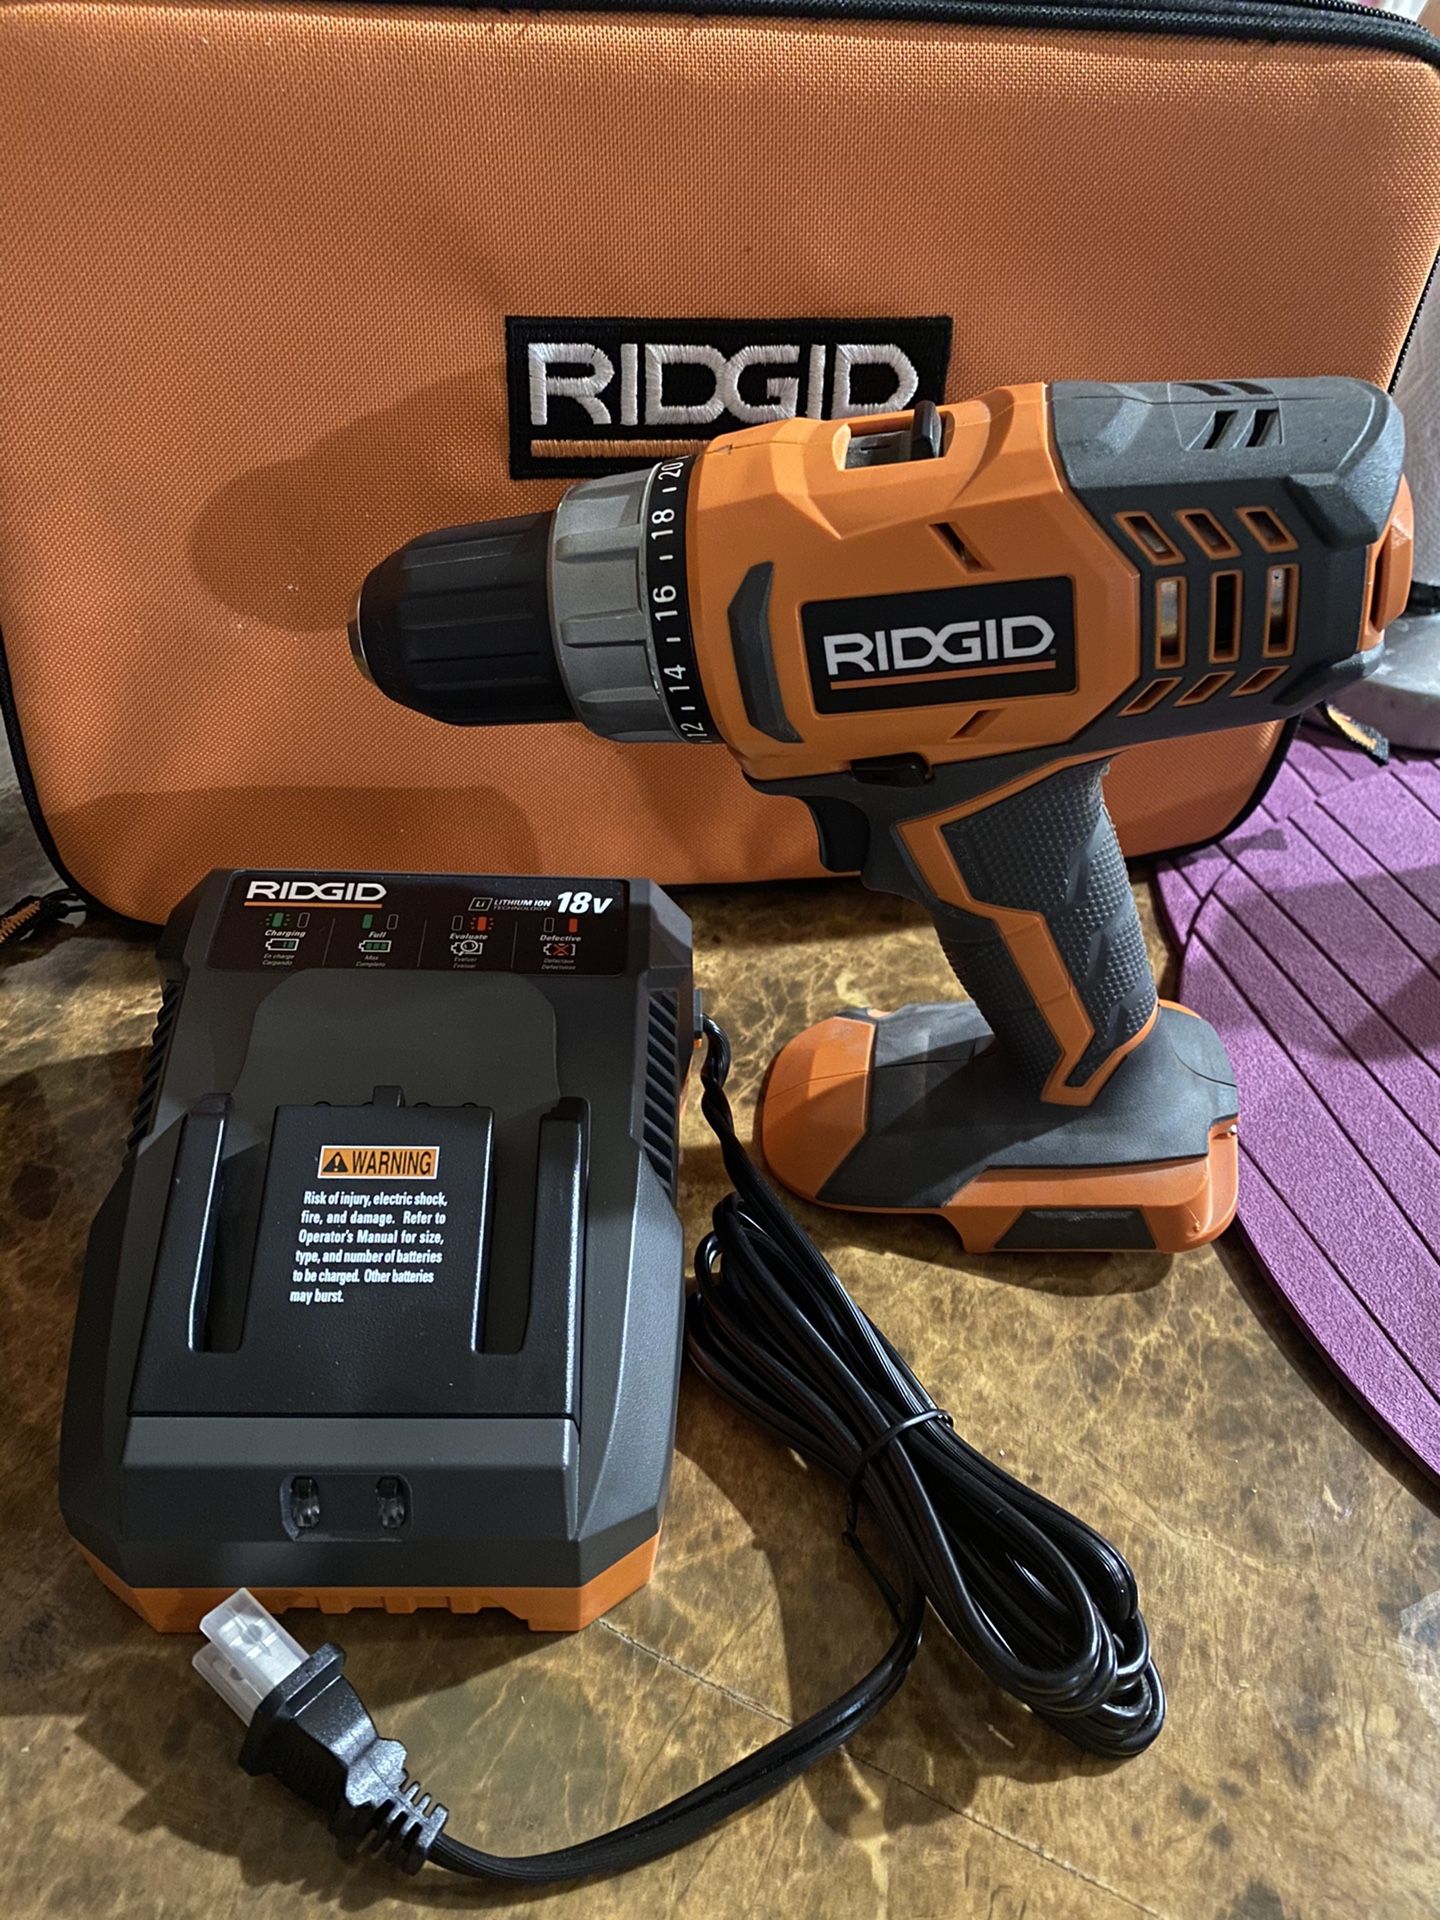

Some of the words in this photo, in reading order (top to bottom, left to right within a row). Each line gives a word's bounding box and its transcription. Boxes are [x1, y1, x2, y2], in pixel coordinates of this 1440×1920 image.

[527, 342, 919, 426] RIDGID
[657, 462, 684, 480] 20
[651, 508, 675, 540] 18
[653, 584, 678, 621] 16
[823, 615, 1056, 676] RIDGID
[663, 664, 690, 693] 14
[680, 722, 708, 738] 12
[246, 881, 388, 901] RIDGID
[494, 899, 532, 907] LITHIUM
[534, 900, 552, 908] ION
[264, 929, 306, 939] Charging
[449, 932, 489, 940] Evaluate
[539, 934, 582, 942] Defective
[352, 1151, 433, 1175] WARNING
[304, 1191, 326, 1205] Risk
[328, 1191, 340, 1205] of
[340, 1192, 372, 1208] injury,
[373, 1192, 413, 1206] electric
[414, 1192, 448, 1207] shock,
[300, 1210, 324, 1226] fire,
[327, 1211, 347, 1225] and
[350, 1211, 396, 1227] damage.
[403, 1211, 432, 1225] Refer
[435, 1212, 446, 1225] to
[298, 1229, 353, 1246] Operator's
[356, 1230, 398, 1244] Manual
[401, 1230, 417, 1244] for
[419, 1230, 445, 1246] size,
[295, 1250, 321, 1266] type,
[322, 1250, 342, 1263] and
[343, 1250, 383, 1264] number
[384, 1250, 396, 1264] of
[396, 1250, 443, 1264] batteries
[292, 1270, 303, 1282] to
[304, 1269, 317, 1283] be
[318, 1269, 360, 1286] charged.
[363, 1269, 391, 1283] Other
[392, 1269, 434, 1284] batteries
[289, 1290, 313, 1305] may
[314, 1289, 344, 1303] burst.
